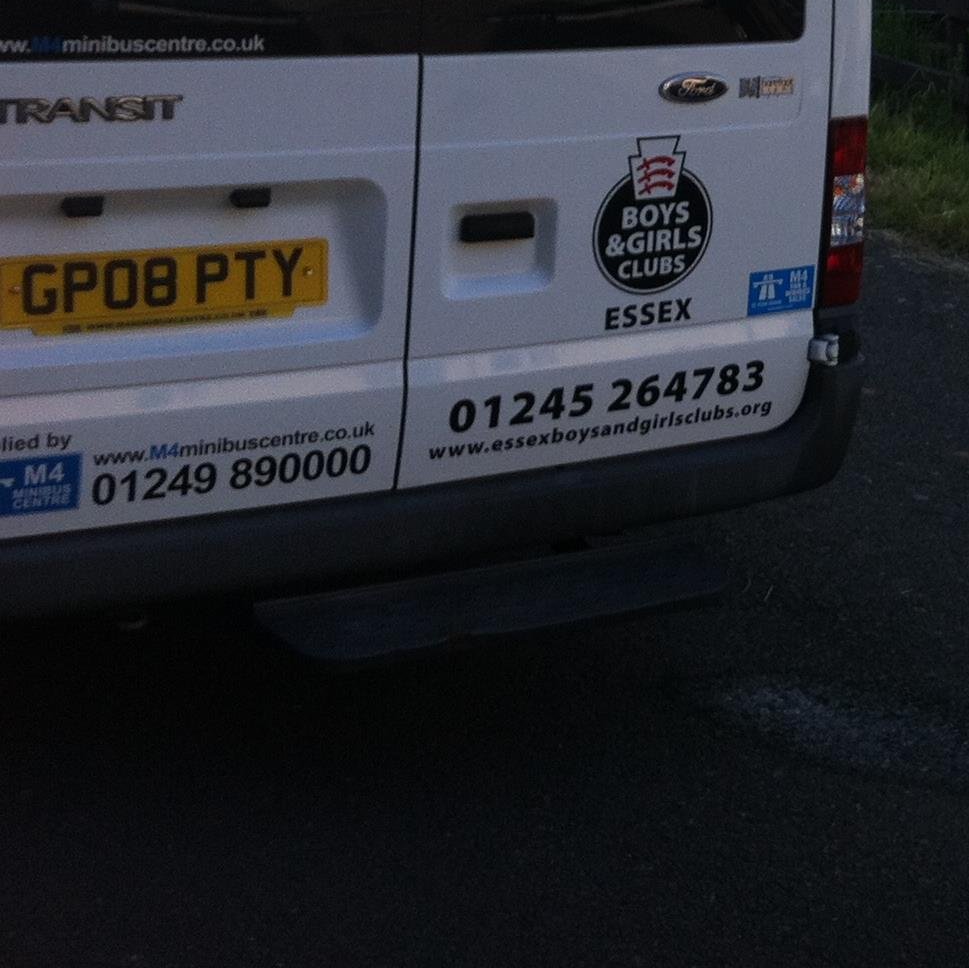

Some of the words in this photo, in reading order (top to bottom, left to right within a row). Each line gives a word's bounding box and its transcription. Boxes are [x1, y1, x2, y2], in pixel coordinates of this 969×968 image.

[677, 77, 717, 97] Ford
[0, 94, 184, 125] TRANSIT
[621, 201, 691, 230] BOYS
[604, 225, 702, 258] &GIRLS
[22, 256, 178, 316] GP08
[195, 247, 304, 306] PTY
[617, 254, 686, 280] CLUBS
[604, 297, 693, 330] ESSEX
[450, 383, 594, 434] 01245
[607, 360, 766, 413] 264783
[47, 433, 72, 450] by
[92, 421, 375, 466] www.M4minibuscentre.co.uk
[428, 400, 773, 460] www.essexboysandgirlsclubs.org
[24, 462, 65, 485] M4
[91, 462, 217, 506] 01249
[230, 444, 372, 491] 890000
[12, 493, 71, 510] CENTRE
[13, 483, 71, 498] MINIBUS
